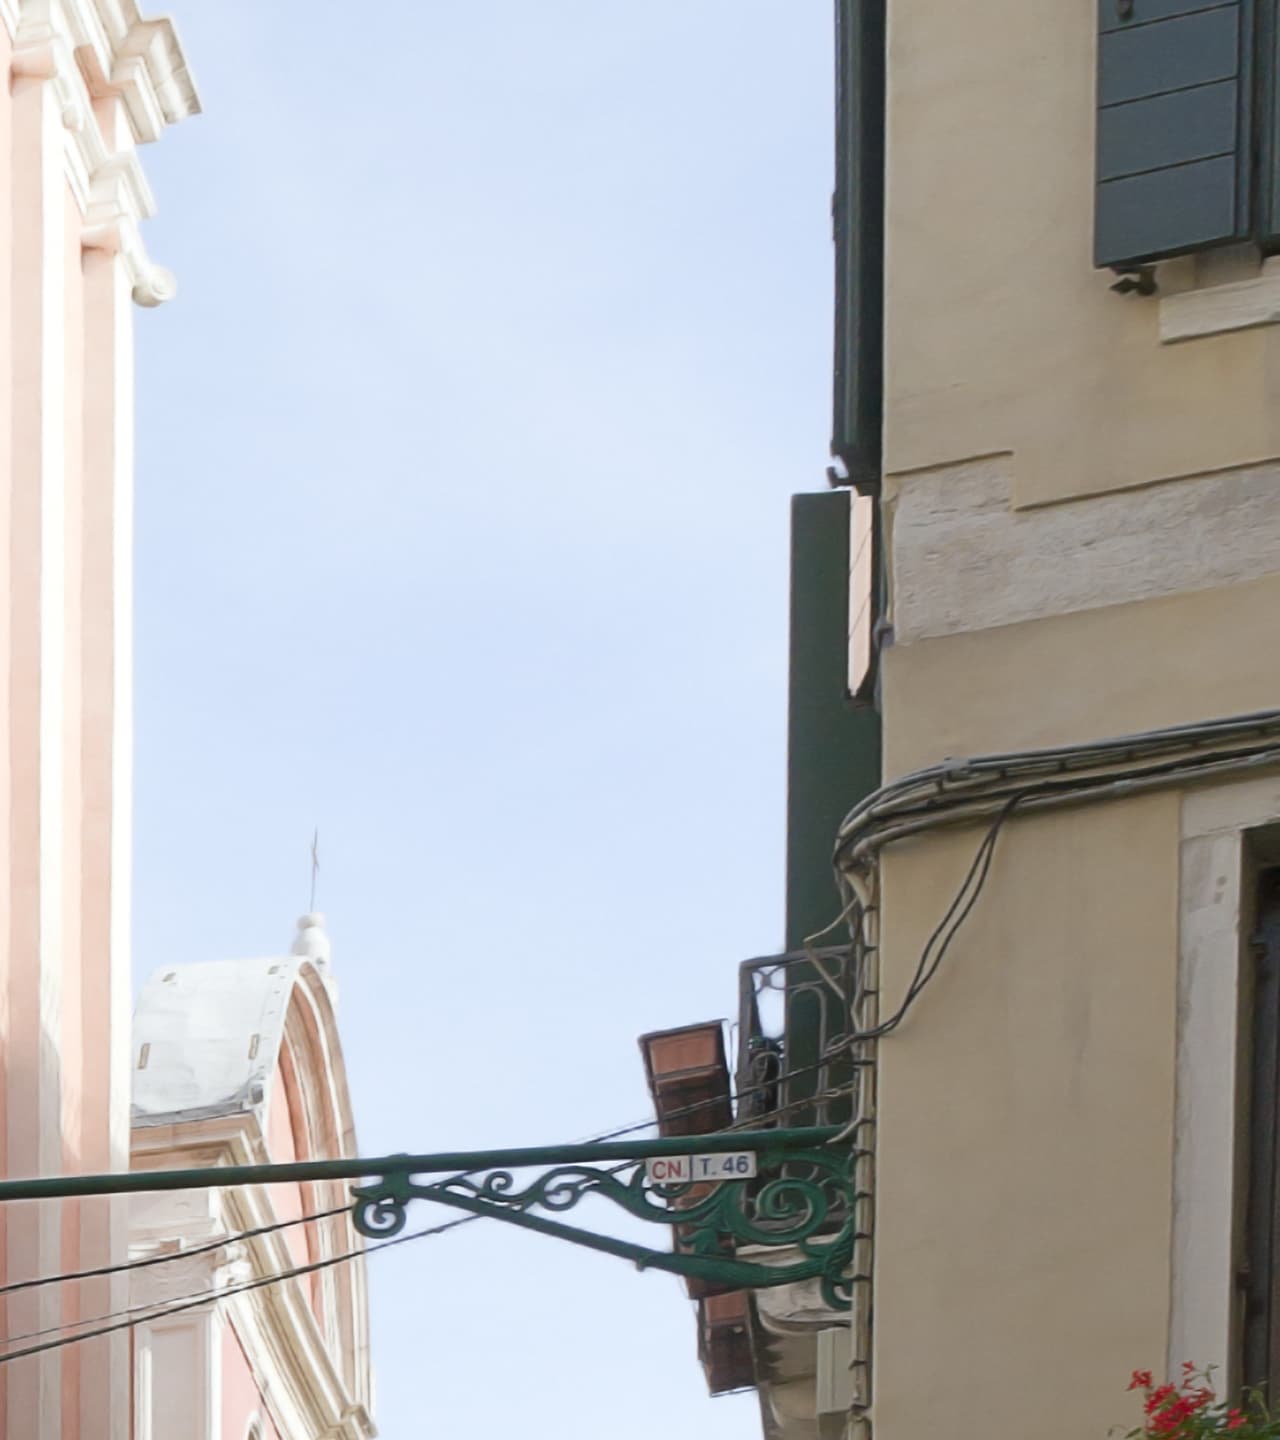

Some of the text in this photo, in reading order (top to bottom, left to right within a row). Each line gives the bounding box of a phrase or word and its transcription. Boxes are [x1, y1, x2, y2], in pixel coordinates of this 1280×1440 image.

[651, 1155, 749, 1180] CN. T. 46
